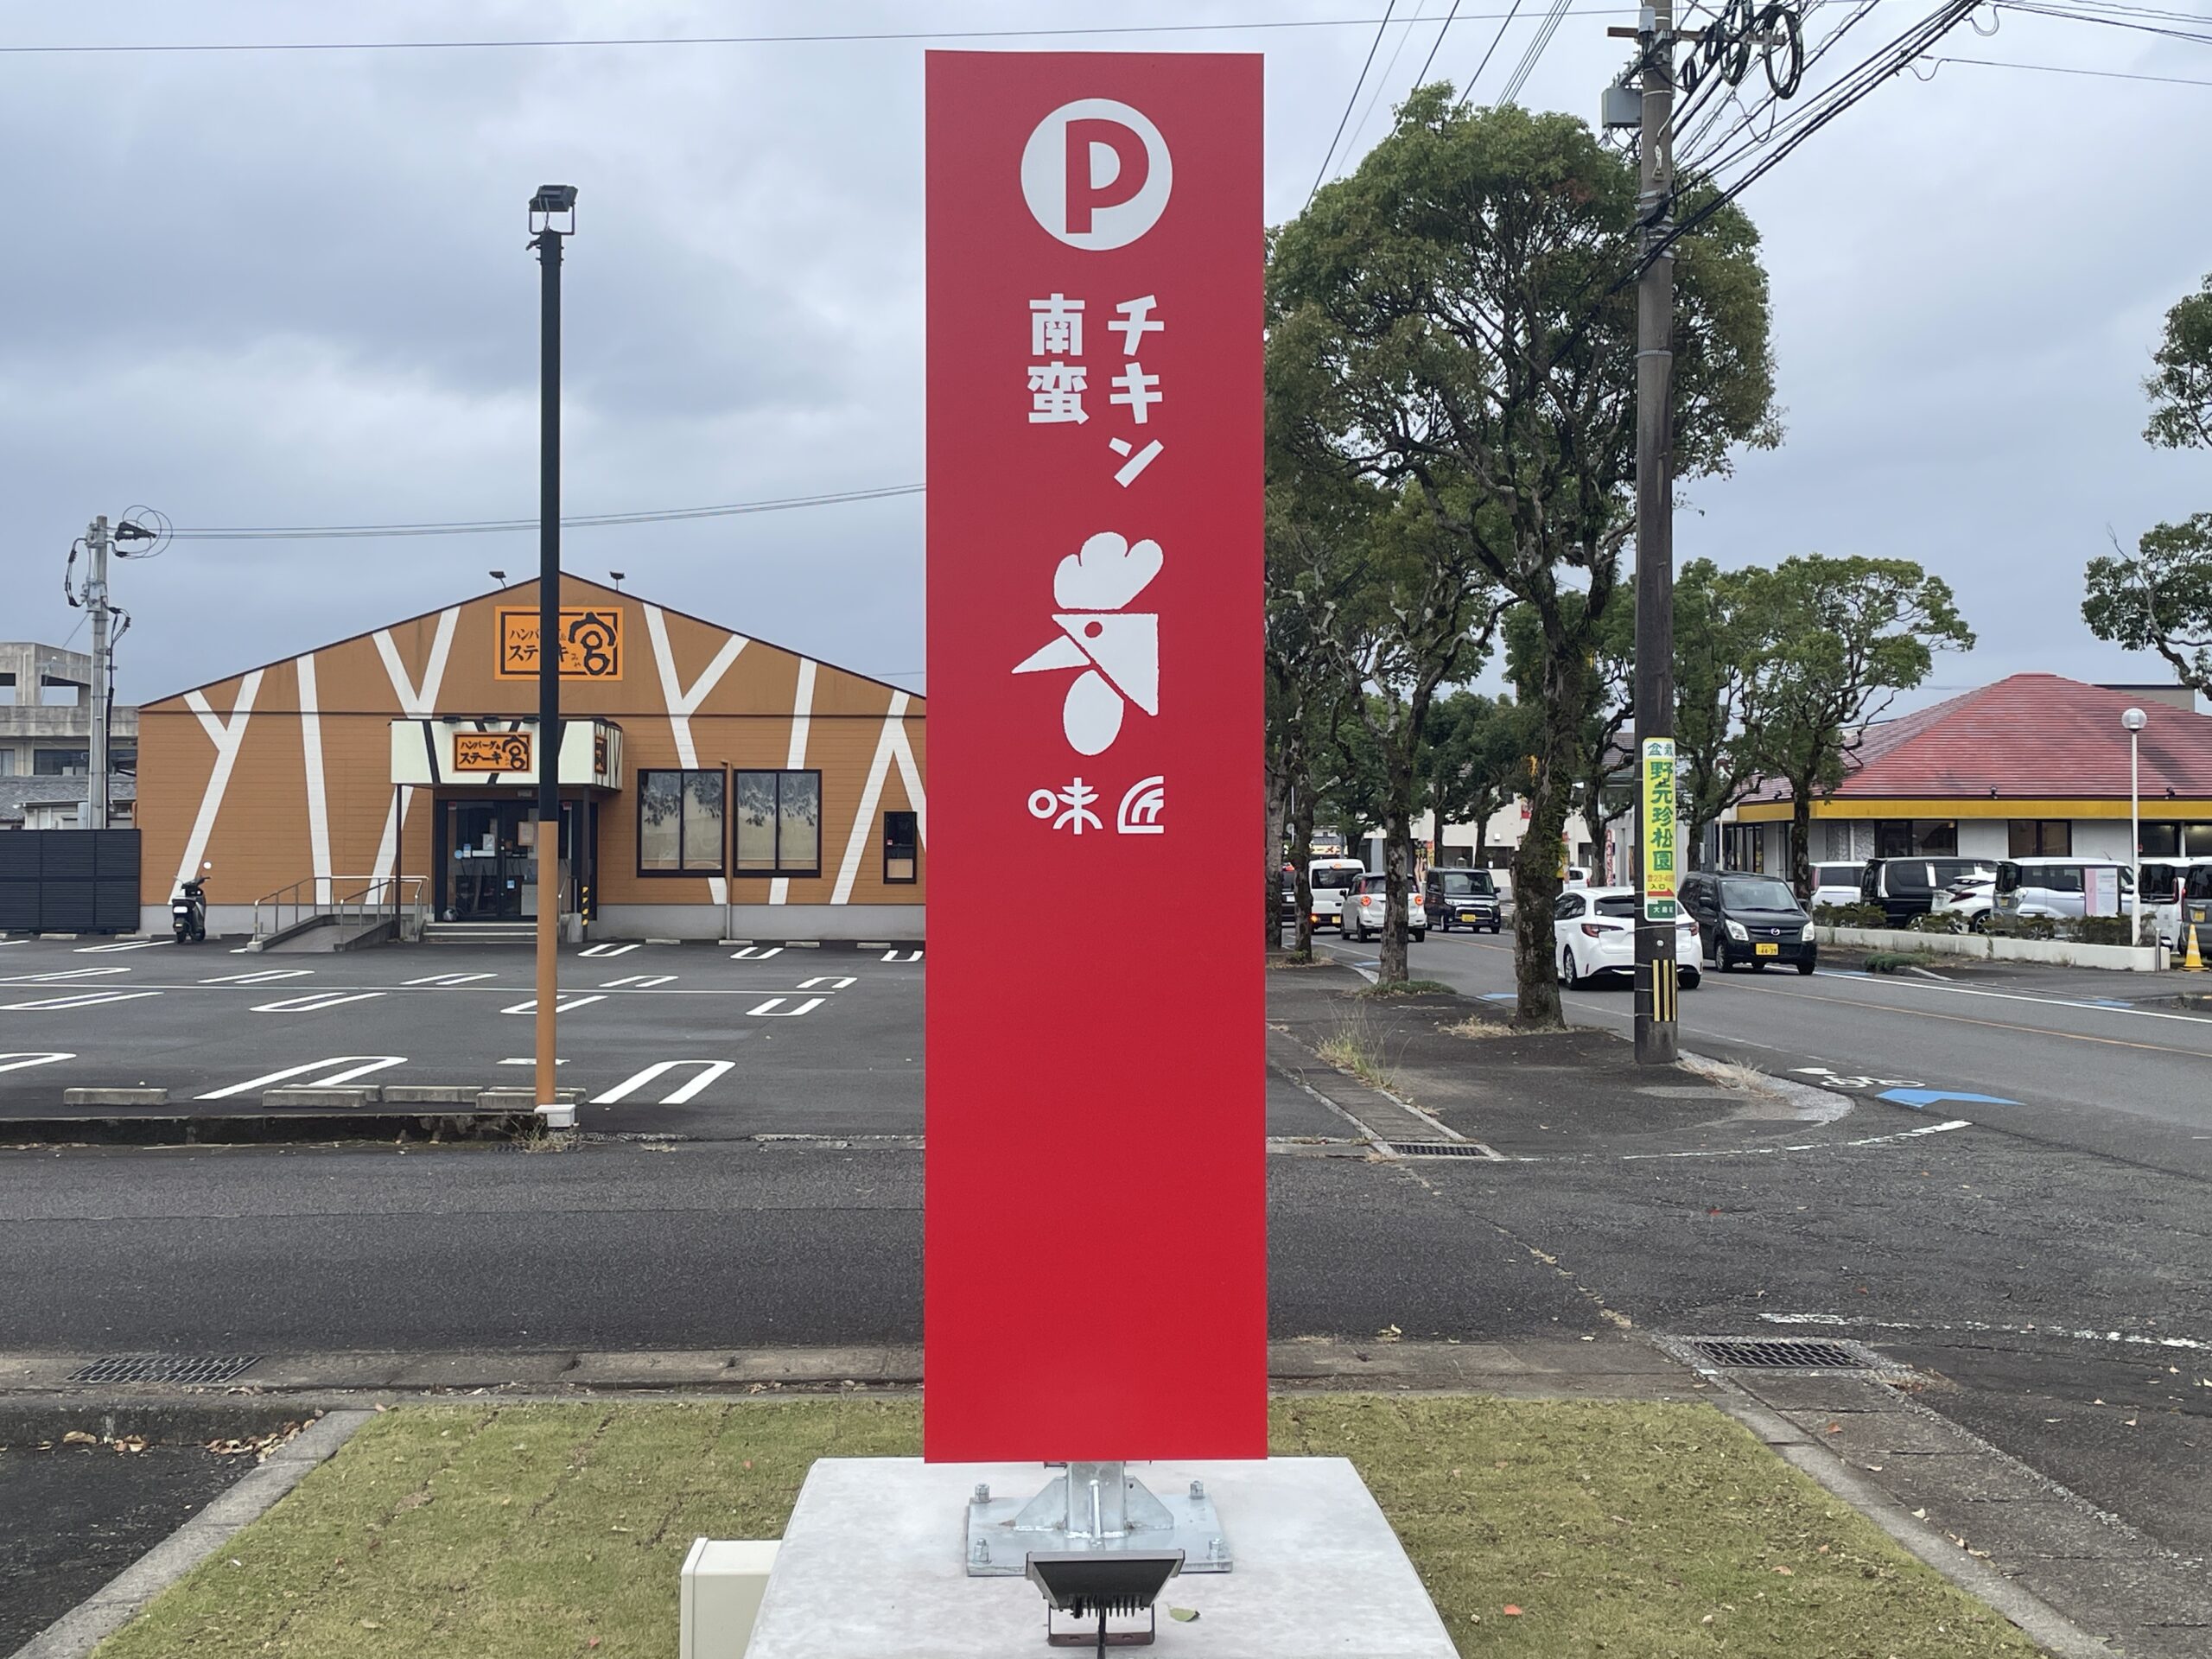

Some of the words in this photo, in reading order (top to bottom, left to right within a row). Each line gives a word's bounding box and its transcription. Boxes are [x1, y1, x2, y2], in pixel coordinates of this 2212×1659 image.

[1066, 118, 1149, 233] P
[1027, 293, 1090, 424] 南蛮
[1108, 295, 1165, 488] チキン
[459, 751, 503, 765] ステーキ
[1027, 776, 1165, 835] 味匠
